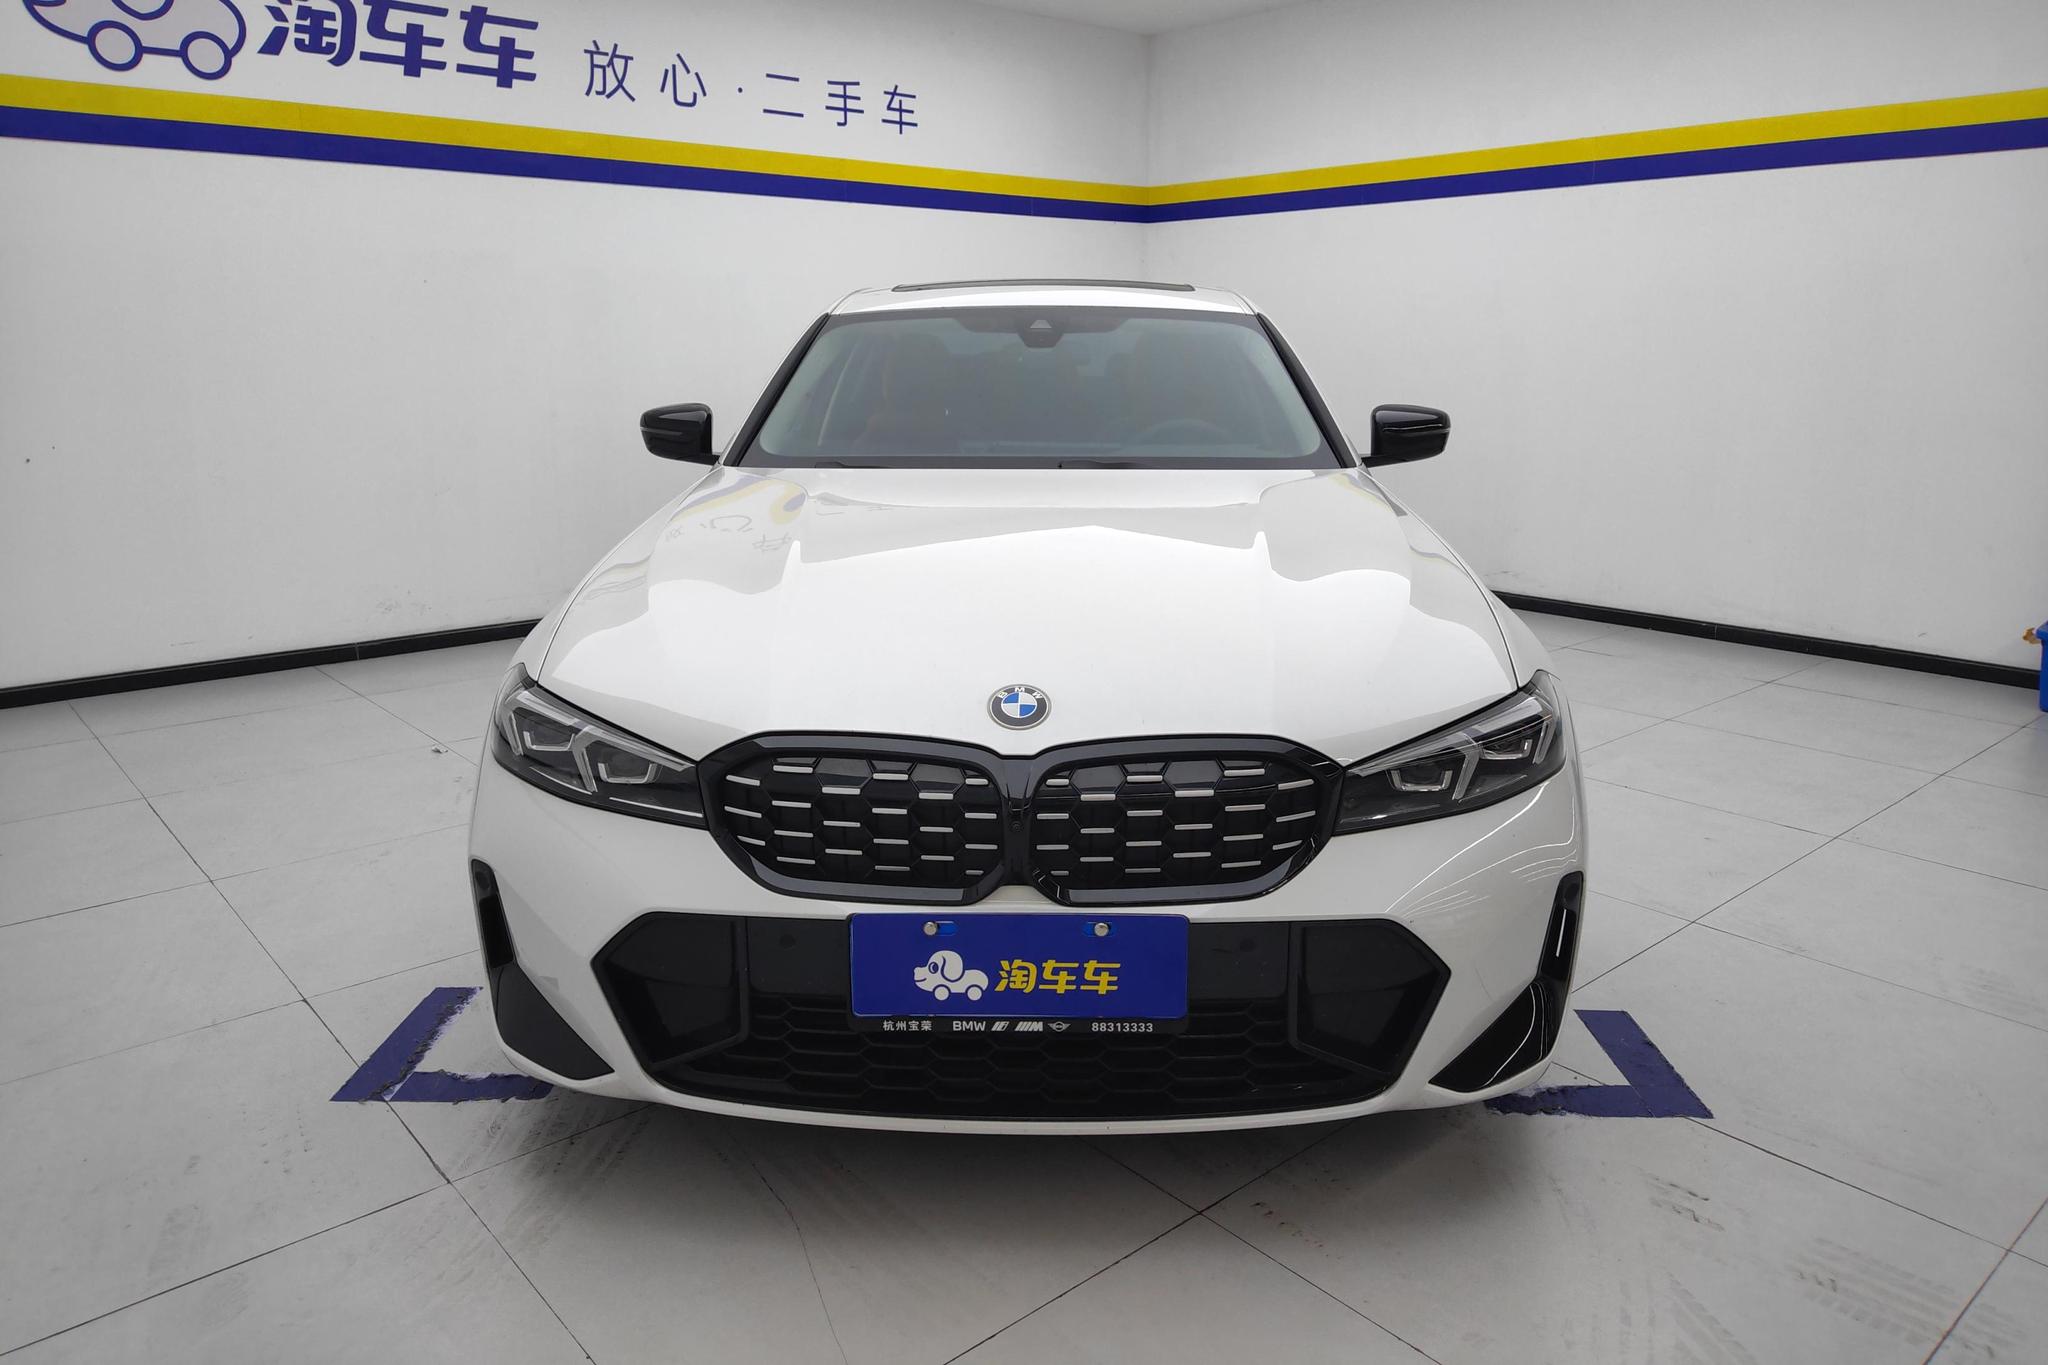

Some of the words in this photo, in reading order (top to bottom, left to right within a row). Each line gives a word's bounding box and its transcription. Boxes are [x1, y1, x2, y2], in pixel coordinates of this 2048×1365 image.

[256, 0, 539, 89] 淘车车
[997, 686, 1043, 699] BMW
[994, 959, 1122, 995] 淘车车
[882, 1019, 933, 1032] 杭州宝荣
[952, 1020, 986, 1032] BMW
[1091, 1022, 1154, 1033] 88313333
